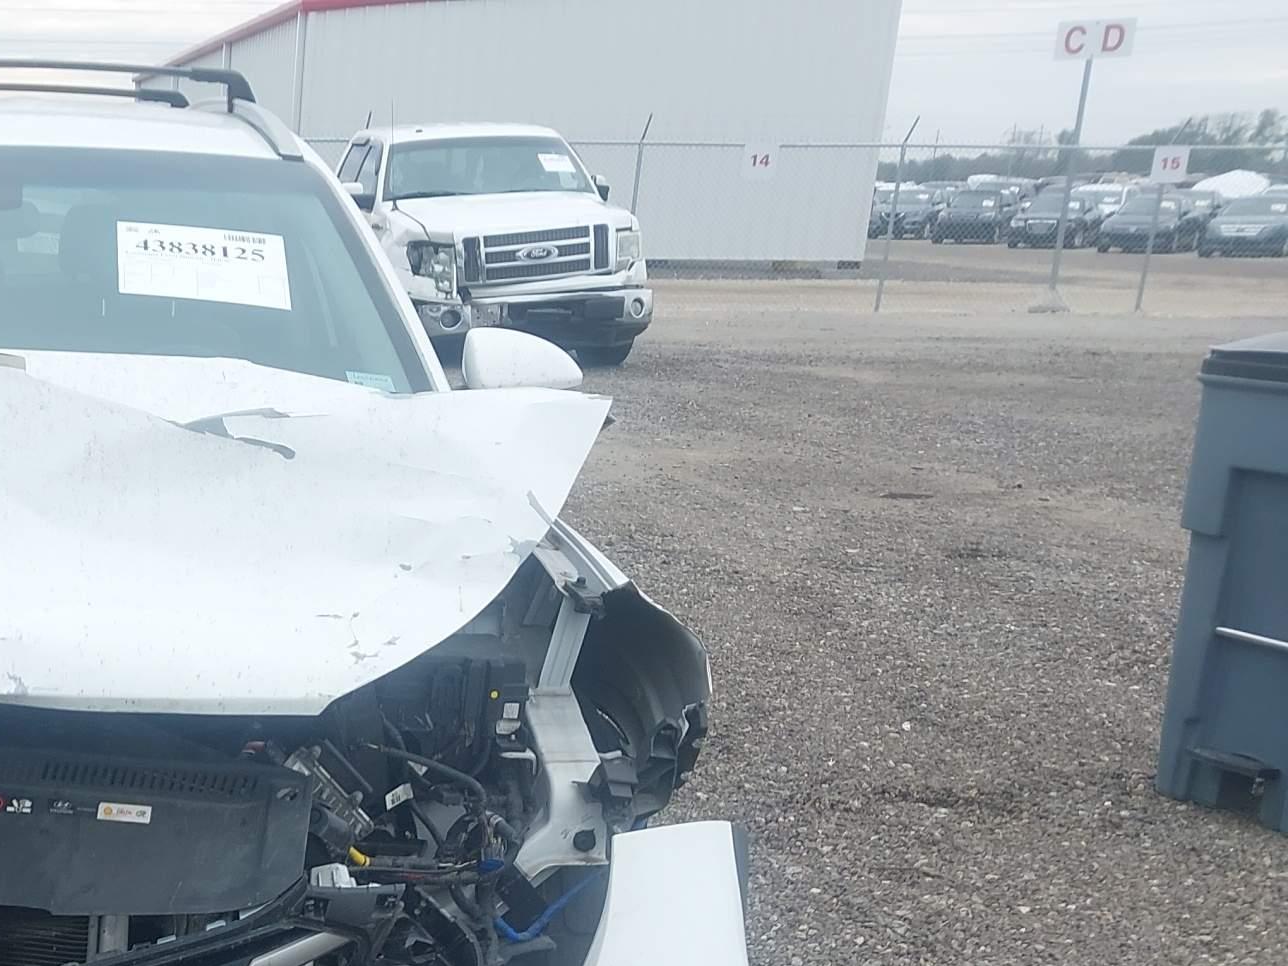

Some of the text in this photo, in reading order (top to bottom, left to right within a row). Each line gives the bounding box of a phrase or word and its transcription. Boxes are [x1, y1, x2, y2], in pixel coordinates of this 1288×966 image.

[1064, 24, 1125, 54] C D
[751, 153, 770, 167] 14
[1161, 156, 1181, 170] 15
[135, 239, 265, 264] 43838125
